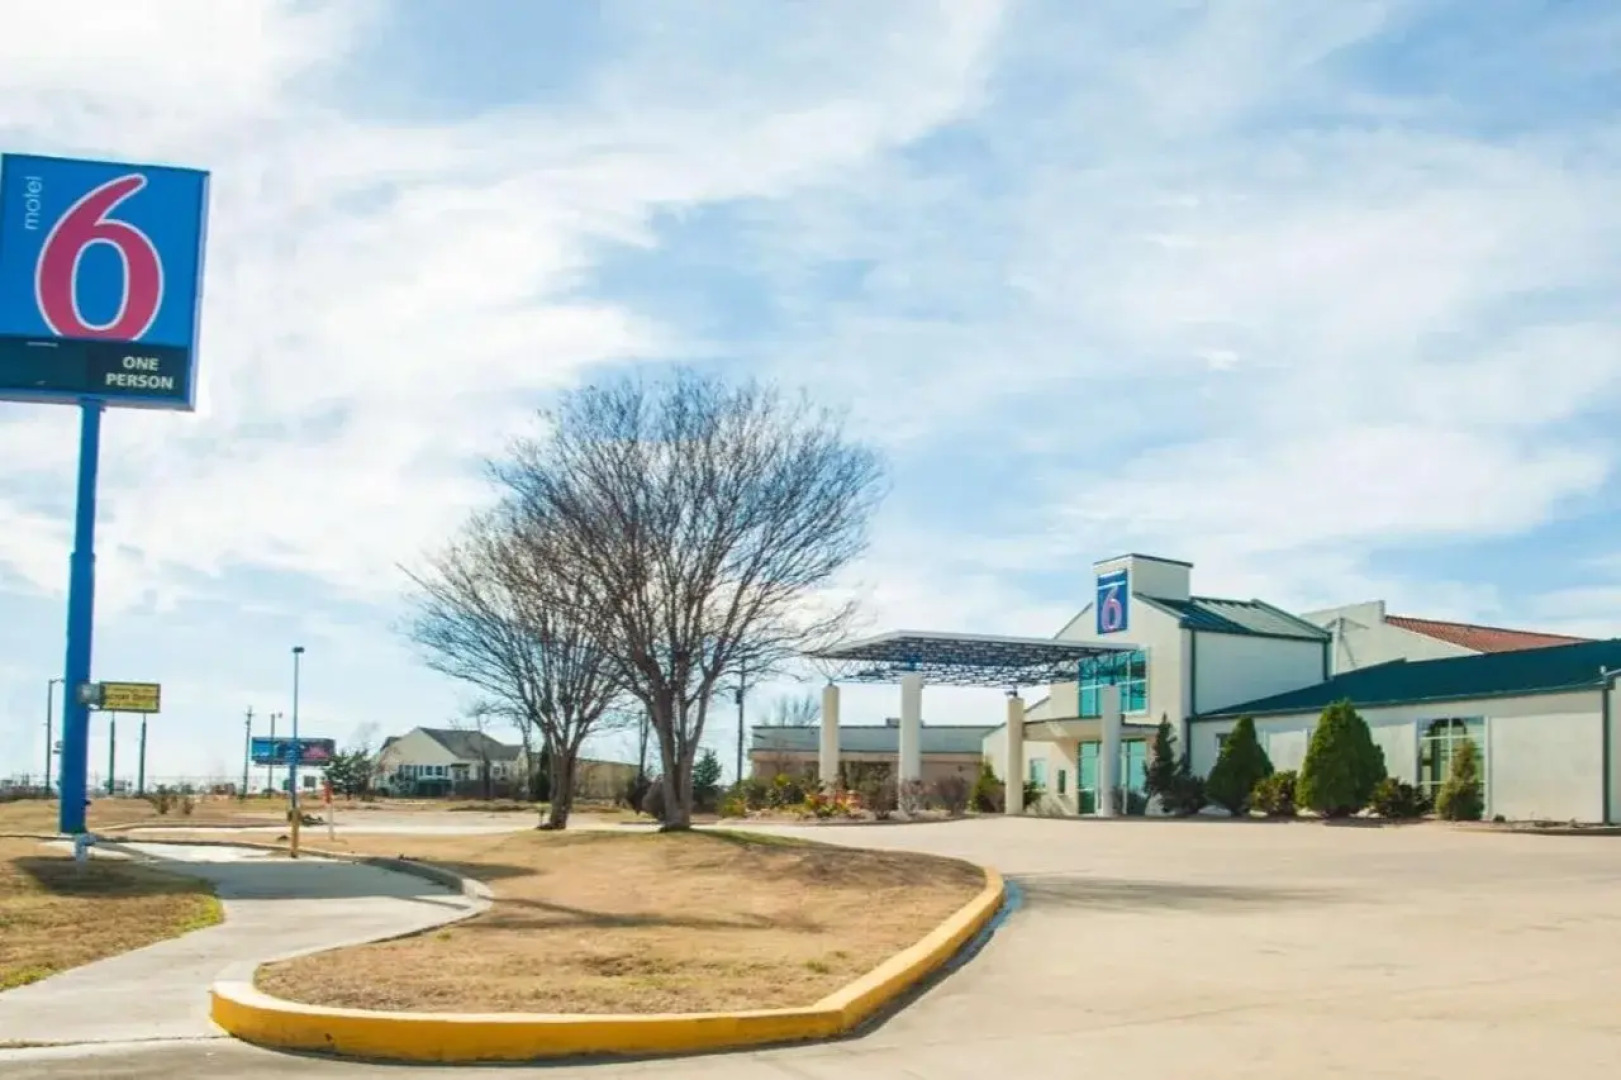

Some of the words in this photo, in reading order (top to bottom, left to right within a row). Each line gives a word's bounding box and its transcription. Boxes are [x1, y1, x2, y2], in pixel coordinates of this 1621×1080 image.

[23, 176, 43, 230] motel
[34, 173, 165, 341] 6
[105, 373, 174, 390] PERSON
[122, 356, 160, 371] ONE
[1101, 584, 1123, 632] 6
